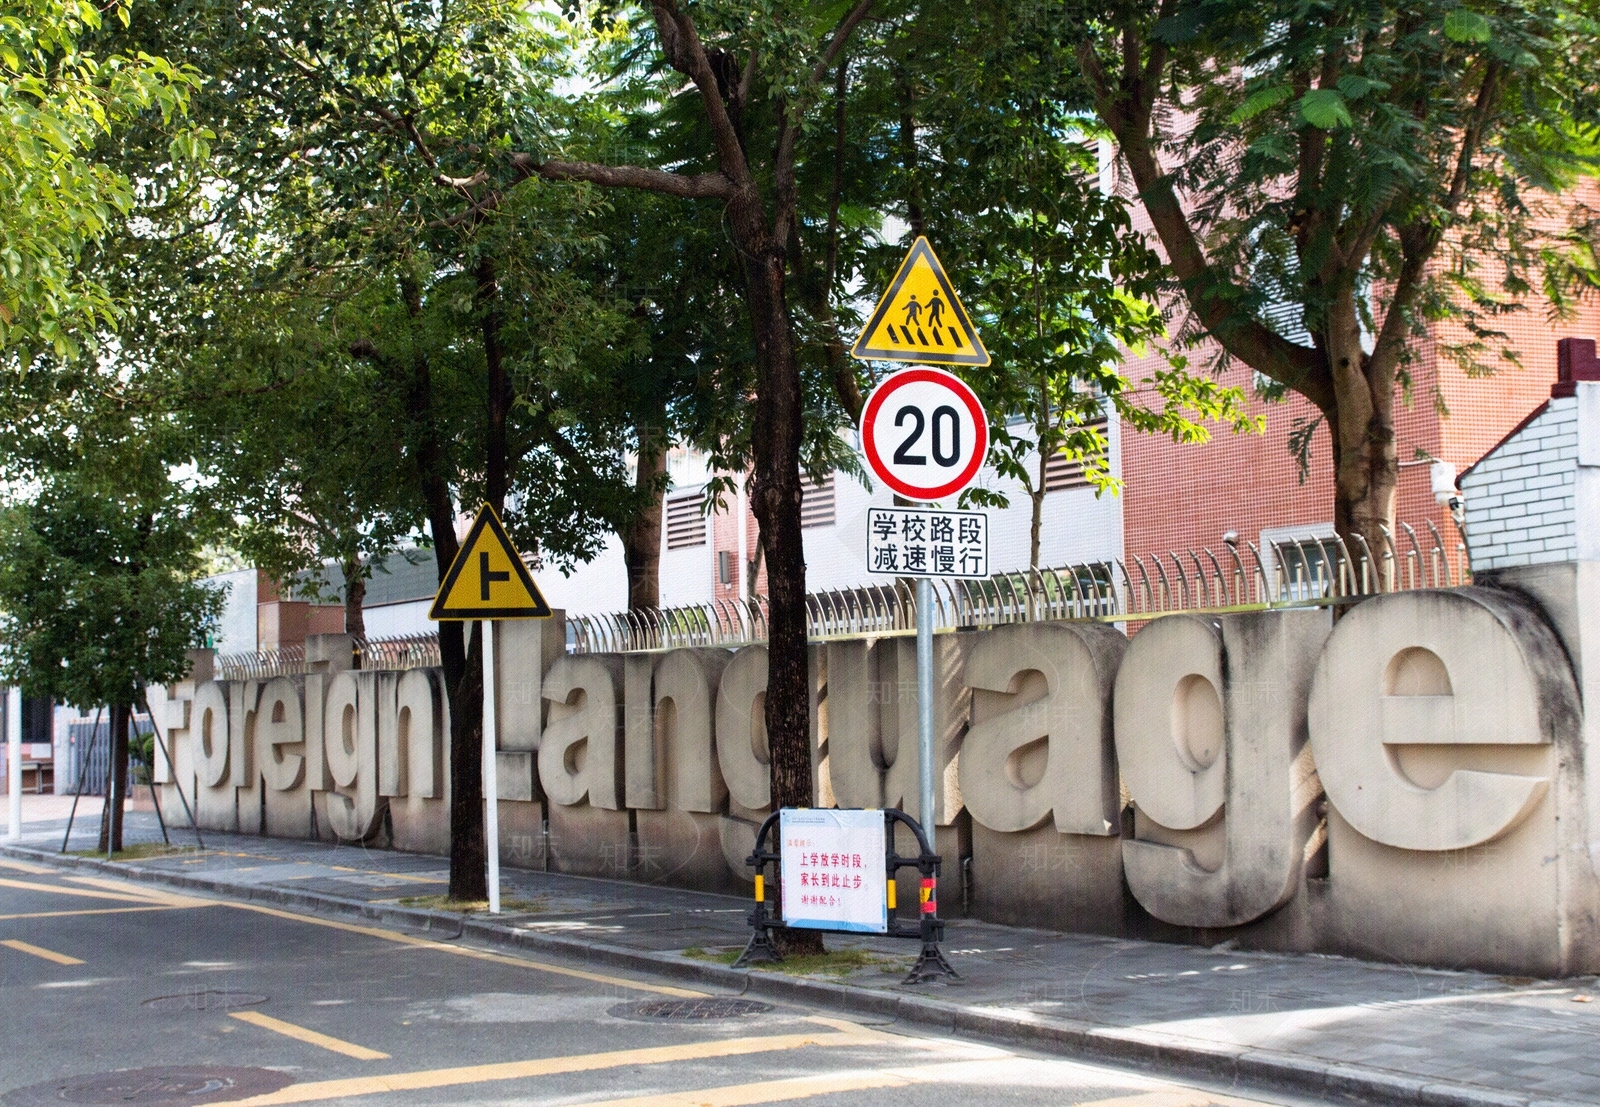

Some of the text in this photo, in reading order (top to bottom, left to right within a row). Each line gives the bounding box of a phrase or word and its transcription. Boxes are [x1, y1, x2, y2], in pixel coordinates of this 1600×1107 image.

[893, 405, 960, 468] 20
[873, 513, 982, 545] 学校路段
[873, 543, 983, 574] 减速慢行
[145, 634, 437, 841] Foreign
